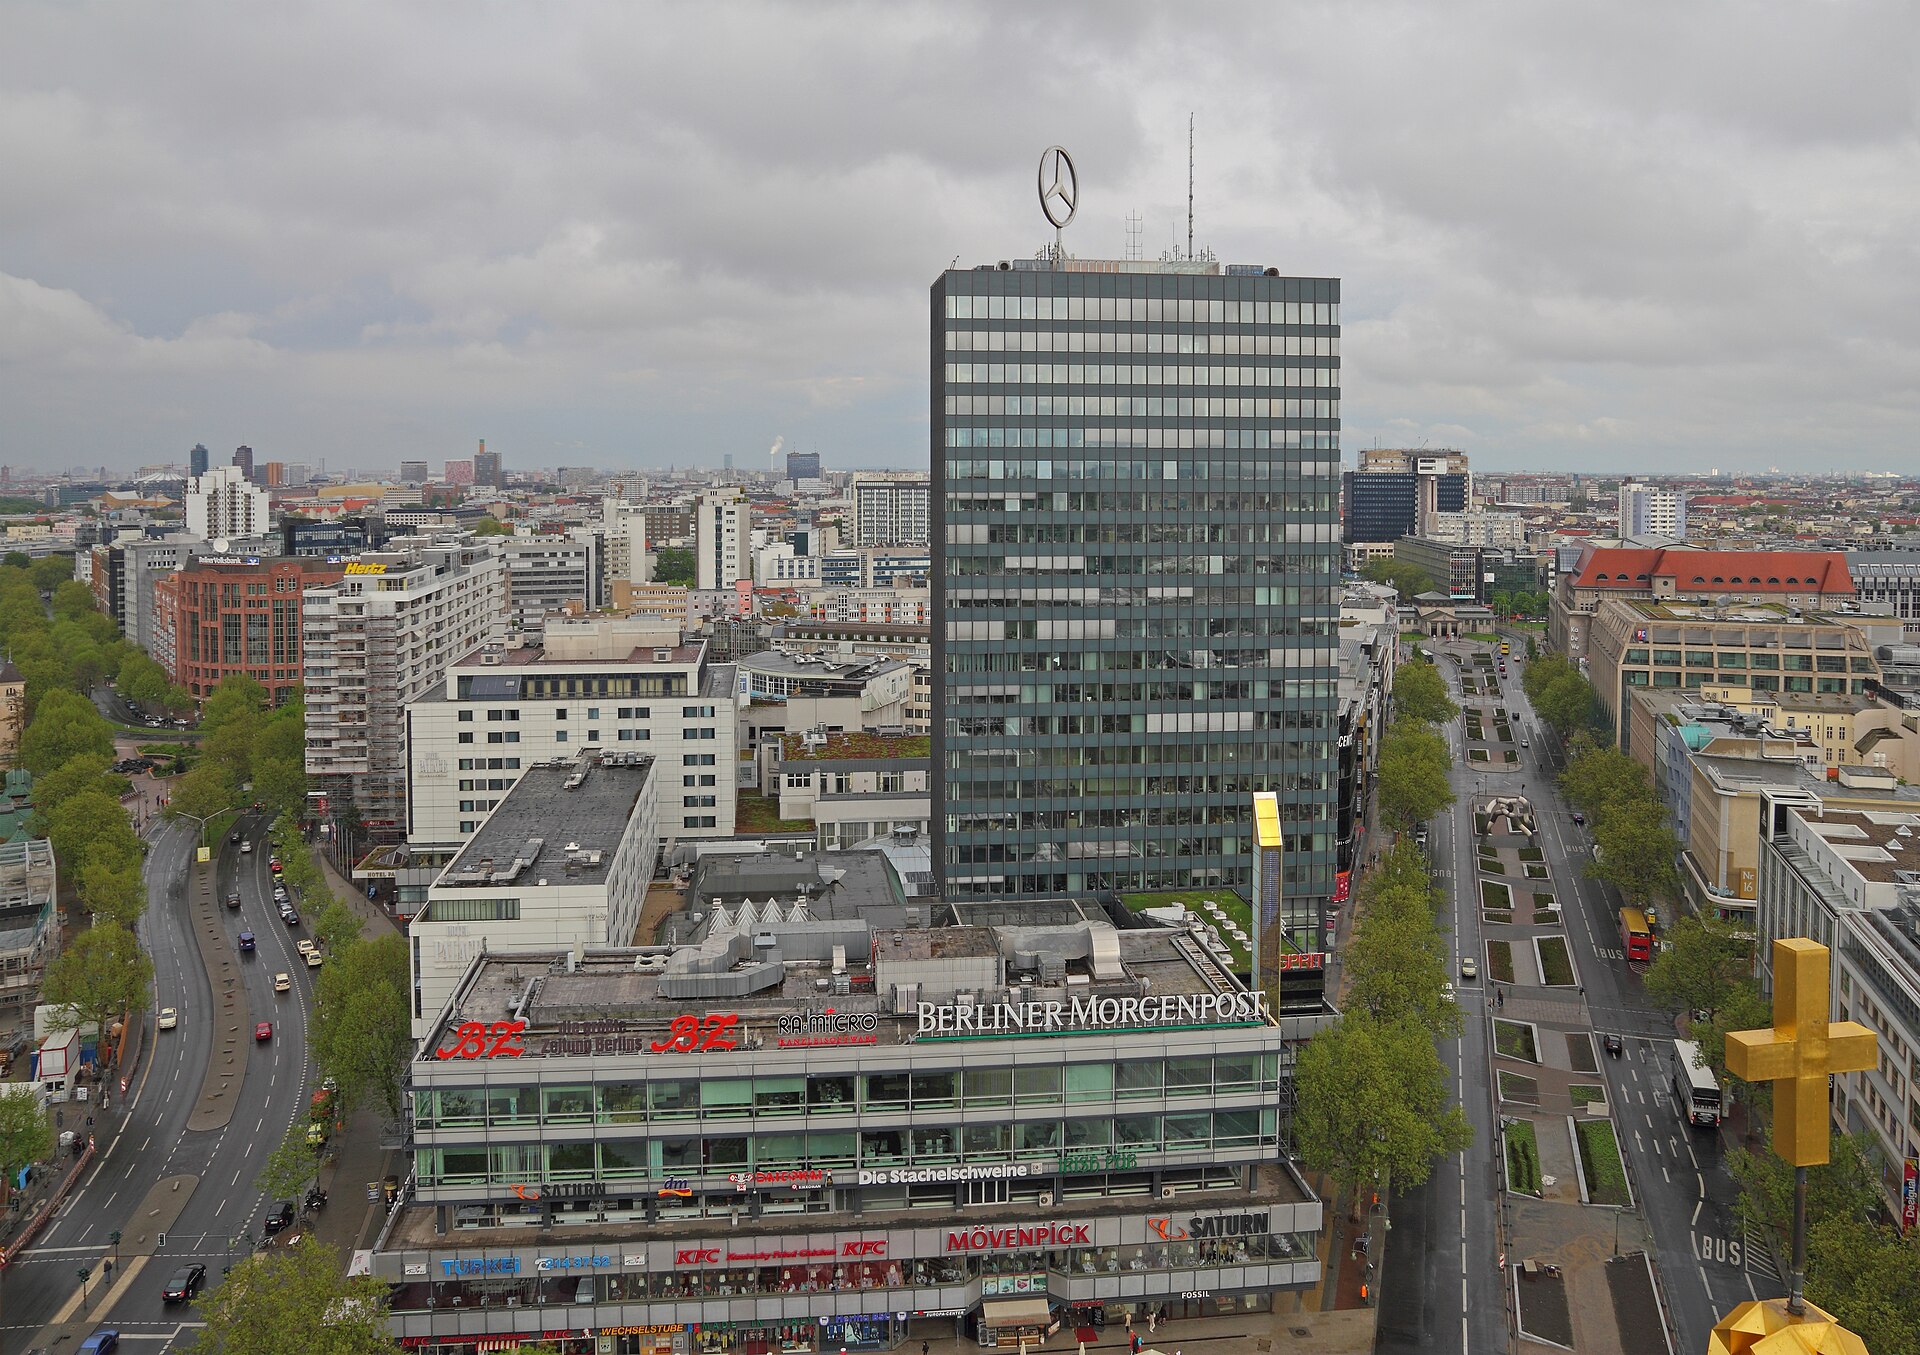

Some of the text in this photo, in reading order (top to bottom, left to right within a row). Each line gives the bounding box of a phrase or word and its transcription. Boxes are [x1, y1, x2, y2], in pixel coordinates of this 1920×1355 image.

[345, 562, 388, 575] Hertz
[1565, 844, 1585, 853] BUS
[1743, 882, 1754, 892] 16
[1600, 948, 1625, 960] BUS
[917, 991, 1266, 1032] BERLINER MORGENPOST
[541, 1034, 643, 1053] Zeitung Berlins
[858, 1169, 887, 1185] Die
[890, 1163, 1028, 1184] Stachelschweine
[541, 1182, 606, 1198] SATURN
[664, 1175, 688, 1190] dm
[1189, 1211, 1269, 1239] SATURN
[946, 1219, 1091, 1251] MÖVENPICK
[675, 1247, 722, 1265] KFC
[841, 1240, 888, 1257] KFC
[1702, 1235, 1741, 1267] BUS
[573, 1256, 588, 1268] 37
[592, 1254, 611, 1267] 52
[1181, 1290, 1210, 1299] FOSSIL
[601, 1323, 684, 1336] WECHSELSTUBE
[702, 1321, 737, 1330] MADE
[751, 1319, 763, 1328] IN
[401, 1336, 432, 1347] KFC
[542, 1329, 574, 1339] KFC
